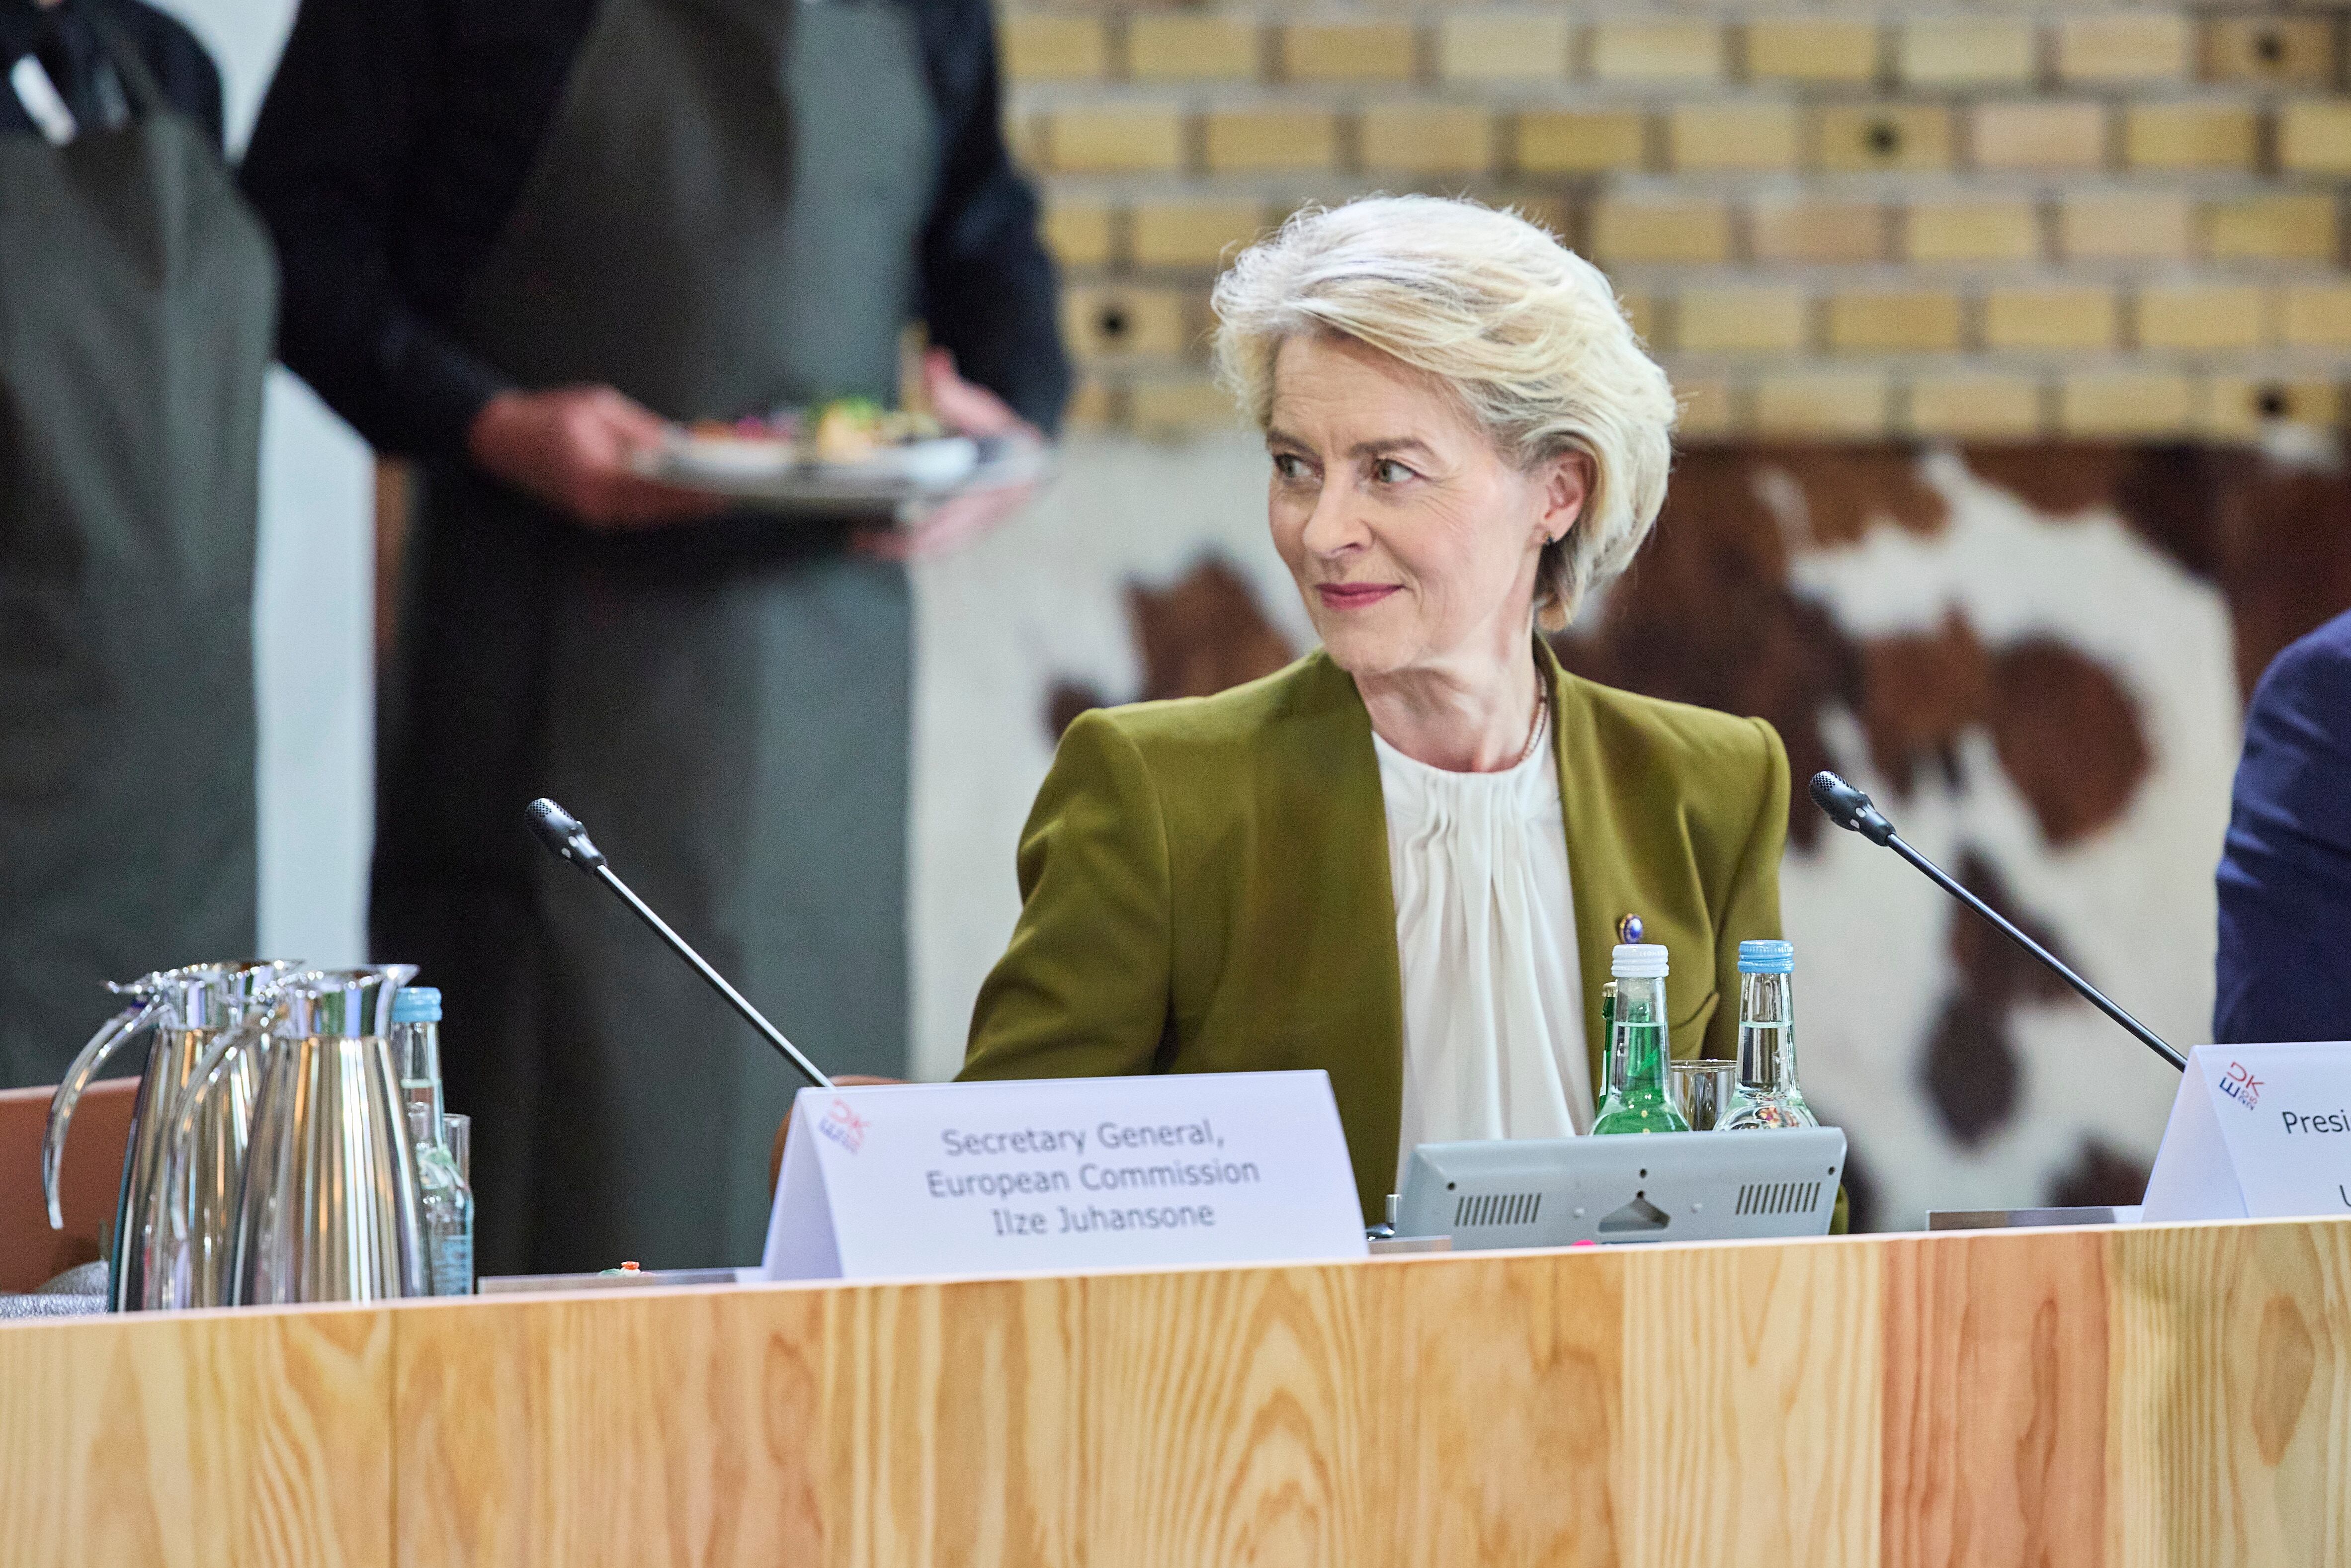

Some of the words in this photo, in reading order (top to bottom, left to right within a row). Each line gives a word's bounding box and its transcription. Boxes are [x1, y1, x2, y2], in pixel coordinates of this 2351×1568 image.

[941, 1127, 1086, 1156] Secretary
[1096, 1118, 1225, 1150] General,
[2281, 1109, 2351, 1134] Presi
[926, 1168, 1071, 1201] European
[1079, 1157, 1260, 1191] Commission
[991, 1206, 1047, 1236] Ilze
[1057, 1203, 1215, 1234] Juhansone
